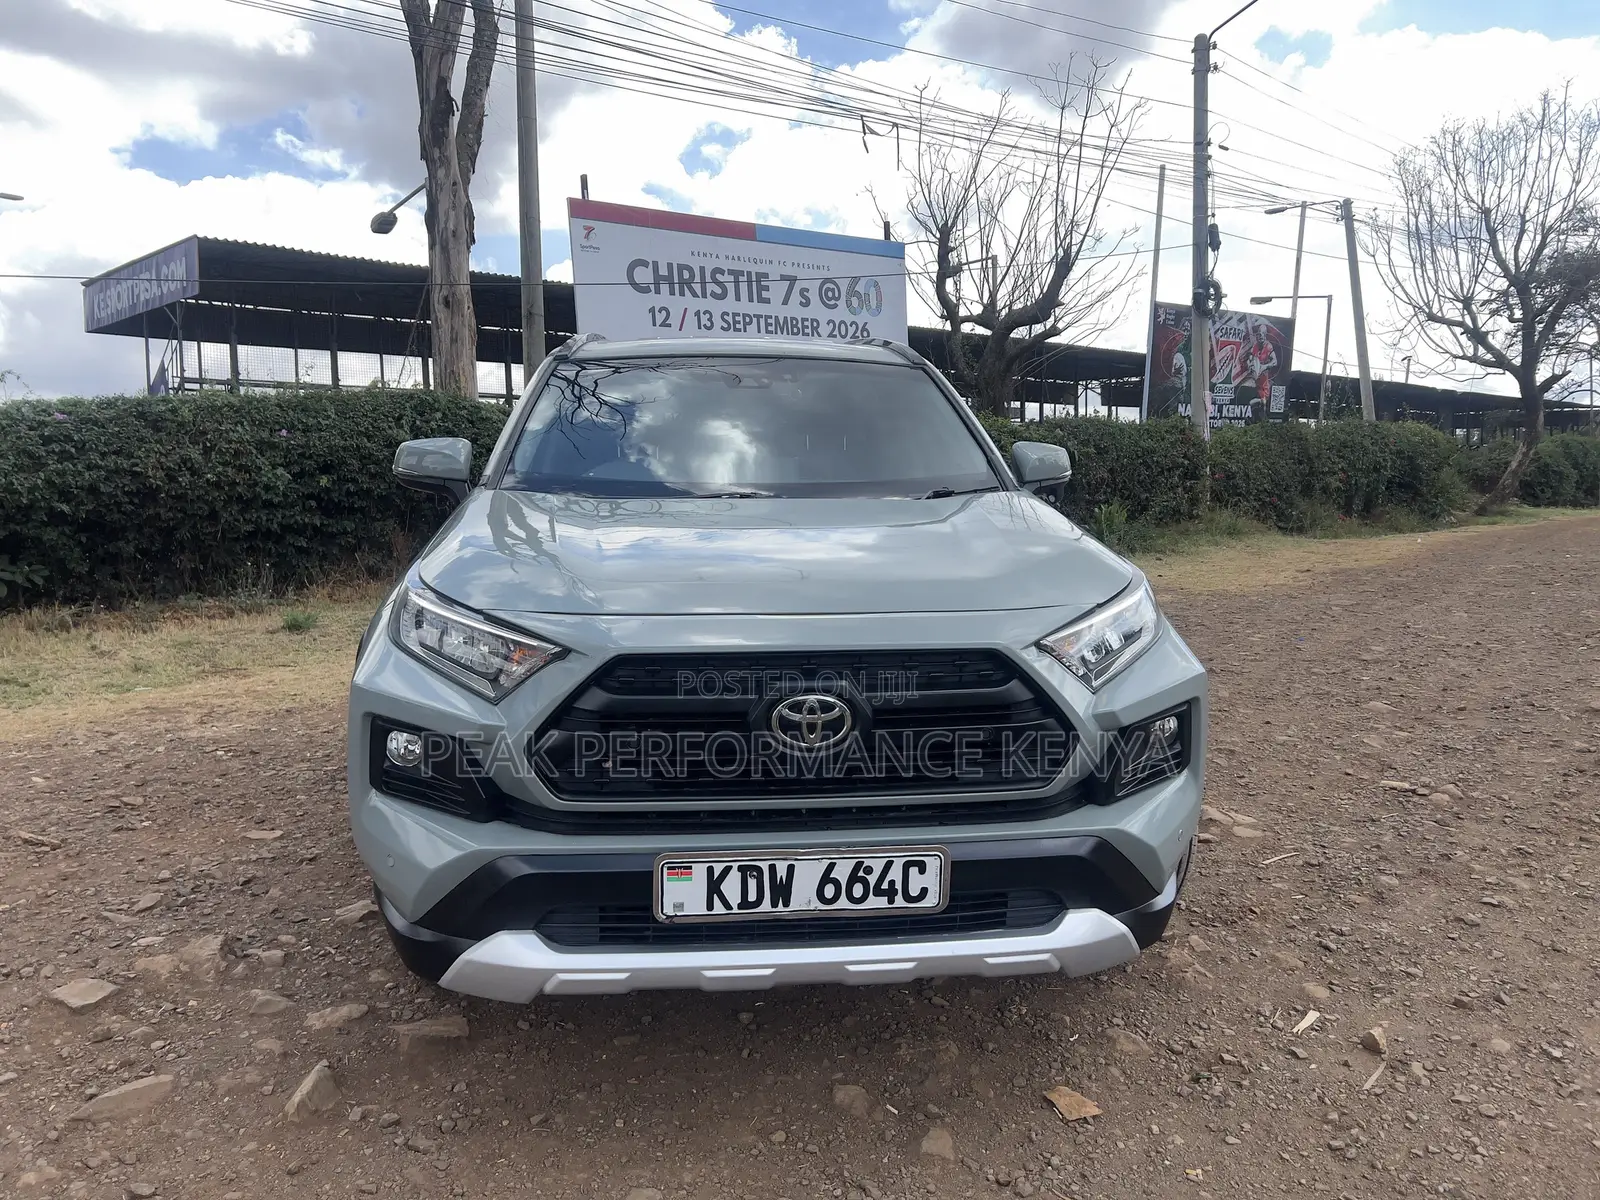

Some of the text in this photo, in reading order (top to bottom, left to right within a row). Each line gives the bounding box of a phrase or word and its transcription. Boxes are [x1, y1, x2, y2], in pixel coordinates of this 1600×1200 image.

[690, 250, 720, 260] KENYA
[725, 254, 774, 266] HARLEQUIN
[791, 261, 831, 272] PRESENTS
[626, 258, 772, 305] CHRISTIE
[779, 273, 811, 308] 7s
[648, 305, 871, 339] 12 / 13 SEPTEMBER 2026
[1220, 326, 1244, 340] SAFARI
[1178, 403, 1253, 419] NABI, KENYA
[706, 862, 796, 911] KDW
[815, 859, 929, 906] 664C
